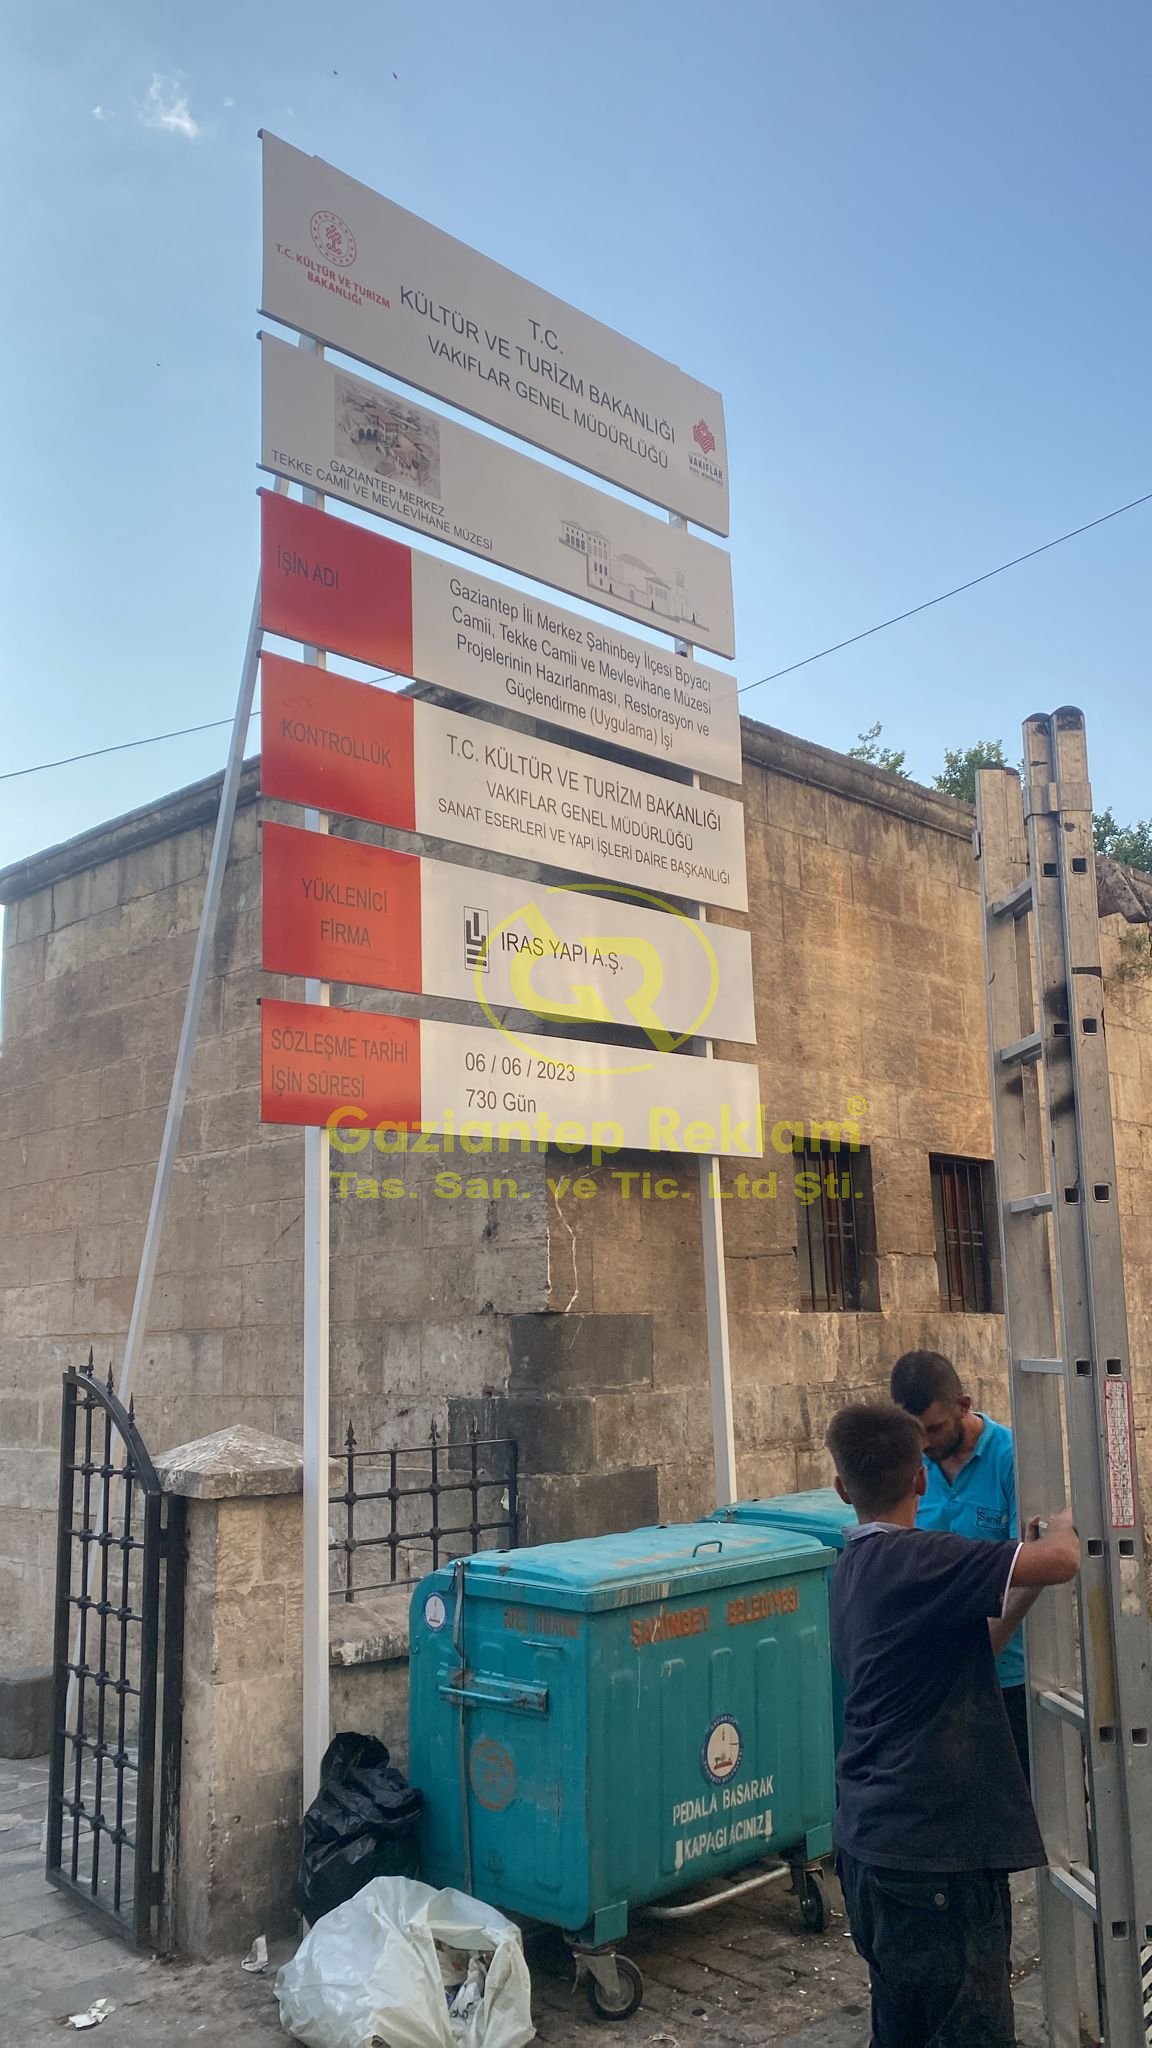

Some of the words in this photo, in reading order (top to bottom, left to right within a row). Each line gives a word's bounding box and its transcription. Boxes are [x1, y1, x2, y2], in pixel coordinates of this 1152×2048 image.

[296, 253, 336, 281] KÜLTÜR
[338, 274, 351, 289] VE
[352, 282, 390, 309] TURİZM
[528, 318, 564, 354] T.C.
[400, 285, 479, 344] KÜLTÜR
[485, 330, 510, 359] VE
[515, 345, 583, 396] TURİZM
[589, 385, 675, 444] BAKANLIĞI
[428, 335, 511, 392] VAKIFLAR
[515, 381, 569, 421] GENEL
[574, 408, 668, 469] MÜDÜRLÜĞÜ
[271, 449, 313, 476] TEKKE
[353, 482, 369, 499] VE
[371, 489, 450, 534] MEVLEVİHANE
[453, 525, 493, 551] MÜZESİ
[330, 459, 396, 495] GAZİANTEP
[399, 488, 445, 518] MERKEZ
[312, 563, 339, 592] ADI
[449, 578, 518, 623] Gaziantep
[537, 611, 582, 644] Merkez
[586, 631, 641, 669] Şahinbey
[452, 605, 495, 640] Camii,
[500, 622, 537, 653] Tekke
[541, 640, 577, 668] Camii
[581, 657, 596, 673] ve
[599, 660, 671, 701] Mevlevihane
[674, 687, 711, 715] Müzesi
[457, 633, 532, 676] Projelerinin
[536, 660, 621, 709] Hazırlanması,
[624, 694, 694, 733] Restorasyon
[696, 722, 710, 737] ve
[505, 678, 586, 720] Güçlendirme
[590, 706, 658, 745] (Uygulama)
[282, 719, 391, 769] KONTROLLÜK
[447, 733, 479, 763] T.C.
[485, 745, 553, 784] KÜLTÜR
[557, 767, 578, 791] VE
[583, 774, 641, 809] TURİZM
[647, 794, 721, 832] BAKANLIĞI
[438, 797, 481, 821] SANAT
[485, 809, 547, 839] ESERLERİ
[549, 826, 566, 844] VE
[568, 831, 594, 850] YAPI
[597, 836, 633, 860] İŞLERİ
[635, 849, 668, 869] DAİRE
[670, 857, 730, 884] BAŞKANLIĞI
[486, 780, 557, 815] VAKIFLAR
[561, 801, 608, 829] GENEL
[611, 815, 693, 851] MÜDÜRLÜĞÜ
[301, 877, 388, 913] YÜKLENİCİ
[320, 918, 371, 948] FİRMA
[501, 931, 544, 957] IRAS
[549, 938, 588, 964] YAPI
[592, 947, 624, 975] A.Ş.
[271, 1025, 357, 1061] SÖZLEŞME
[361, 1037, 408, 1065] TARİHİ
[465, 1052, 486, 1073] 06
[501, 1056, 522, 1077] 06
[537, 1060, 576, 1082] 2023
[307, 1069, 365, 1098] SÜRESİ
[465, 1088, 497, 1110] 730
[502, 1092, 537, 1113] Gün
[673, 1793, 718, 1828] PEDALA
[722, 1774, 774, 1811] BASARAK
[684, 1826, 727, 1861] KAPAGI
[728, 1814, 764, 1846] ACINIZ
